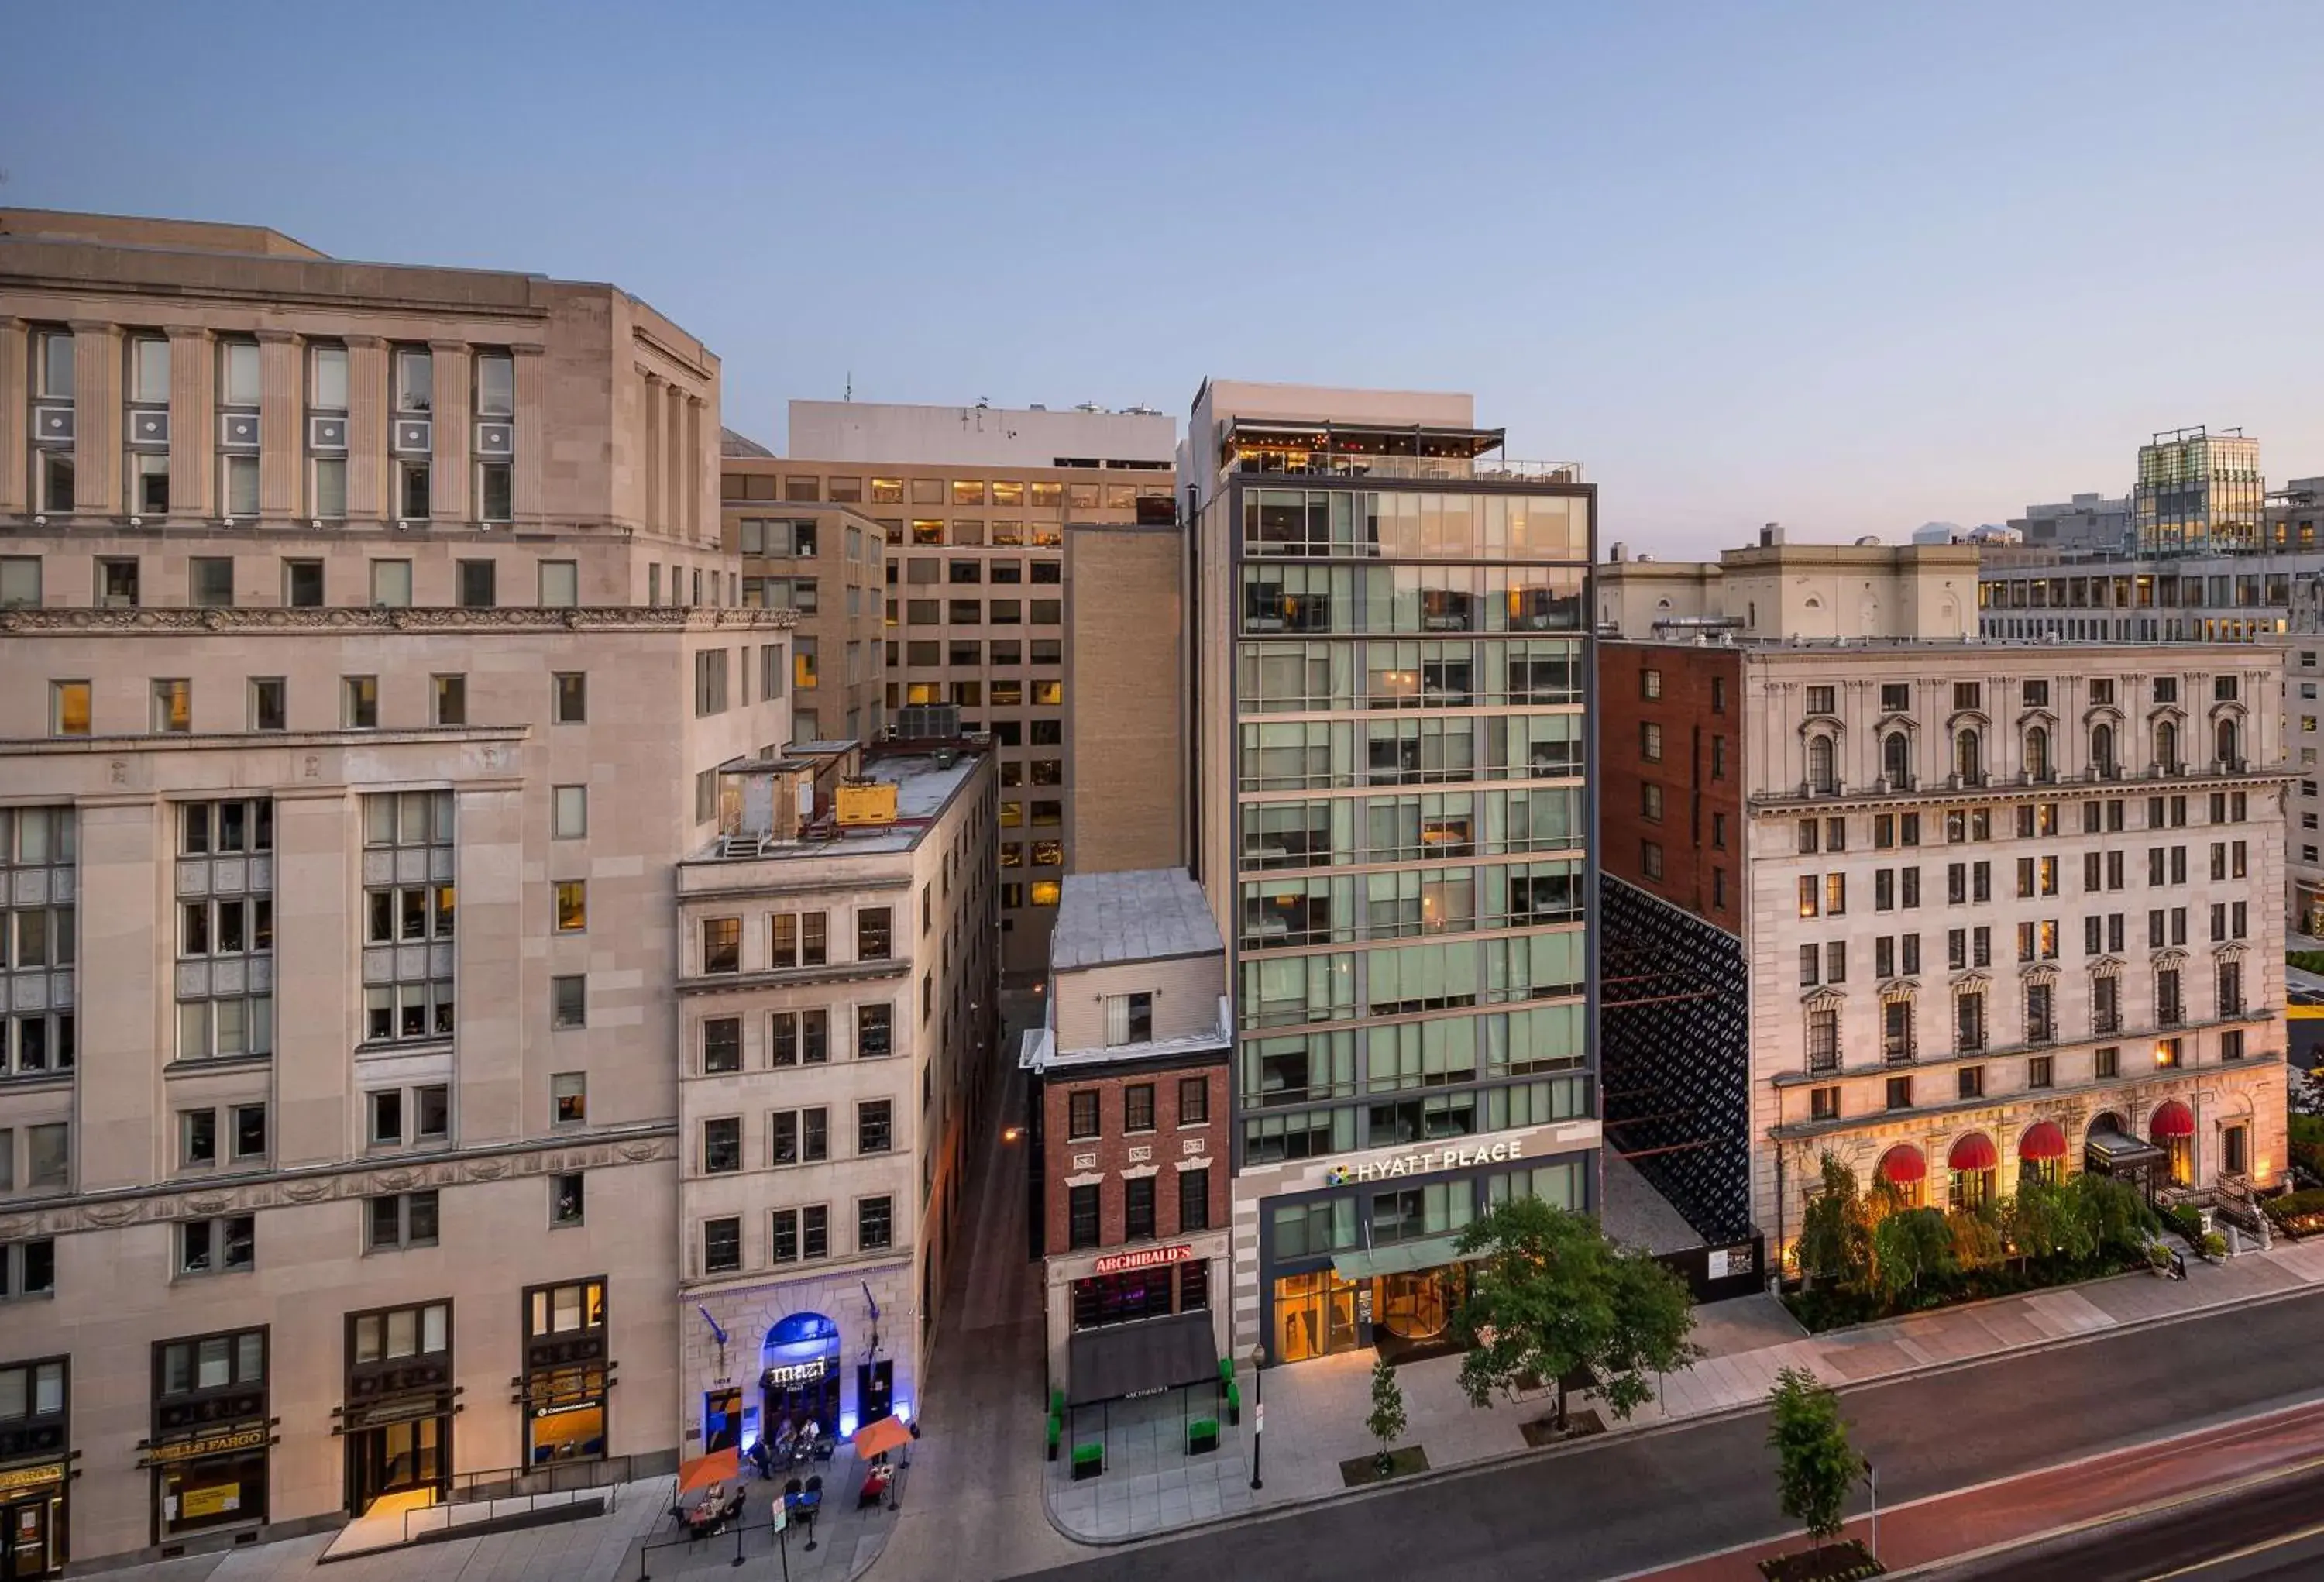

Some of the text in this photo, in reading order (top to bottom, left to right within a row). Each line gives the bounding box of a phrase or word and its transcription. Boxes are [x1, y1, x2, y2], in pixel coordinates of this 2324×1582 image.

[1358, 1140, 1522, 1182] HYATT PLACE
[1096, 1245, 1191, 1273] ARCHIBALD'S
[771, 1356, 826, 1384] mazi
[152, 1432, 261, 1460] WELLS FARGO
